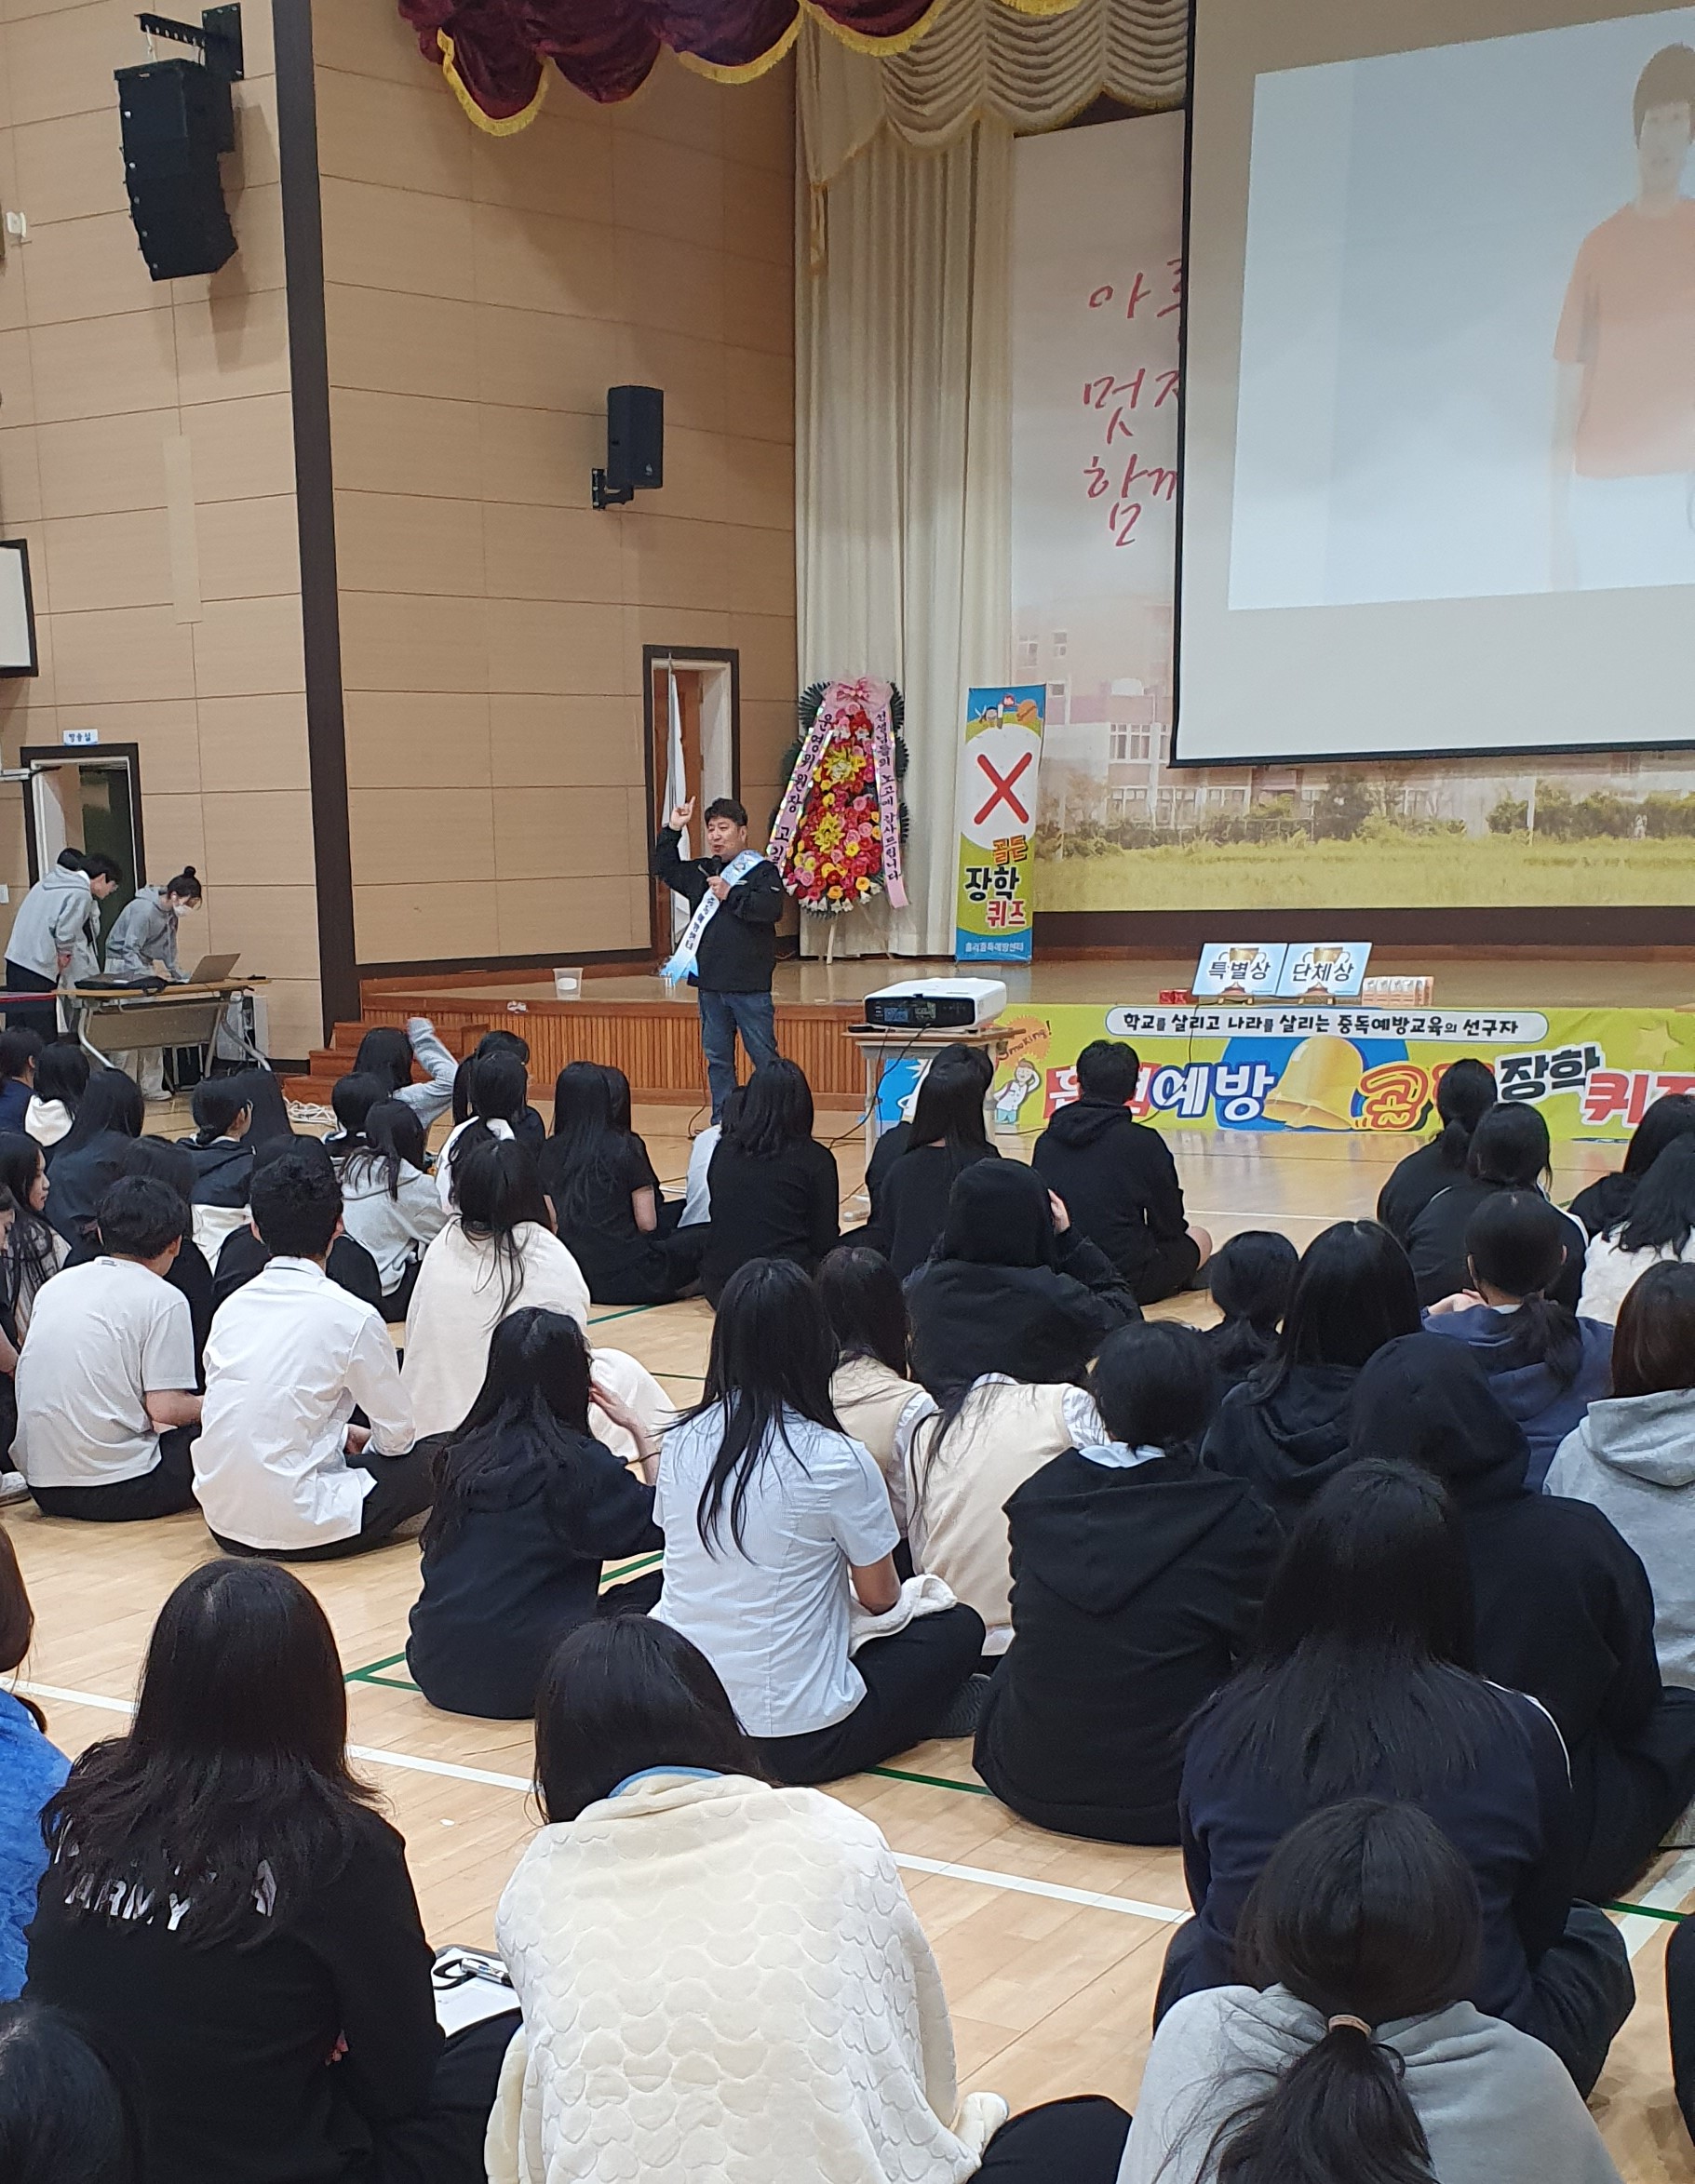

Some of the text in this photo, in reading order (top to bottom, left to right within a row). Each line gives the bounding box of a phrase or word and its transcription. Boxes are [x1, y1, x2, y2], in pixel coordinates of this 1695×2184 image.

[883, 812, 901, 881] 감사드립니다
[993, 835, 1029, 866] 골든
[964, 866, 1019, 902] 장학
[987, 901, 1026, 927] 퀴즈
[1207, 960, 1271, 981] 특별상
[1292, 961, 1355, 983] 단체상
[1123, 1012, 1519, 1037] 학교를 살리고 나라를 살리는 중독예방교육의 선구자
[1500, 1046, 1600, 1101] 장학
